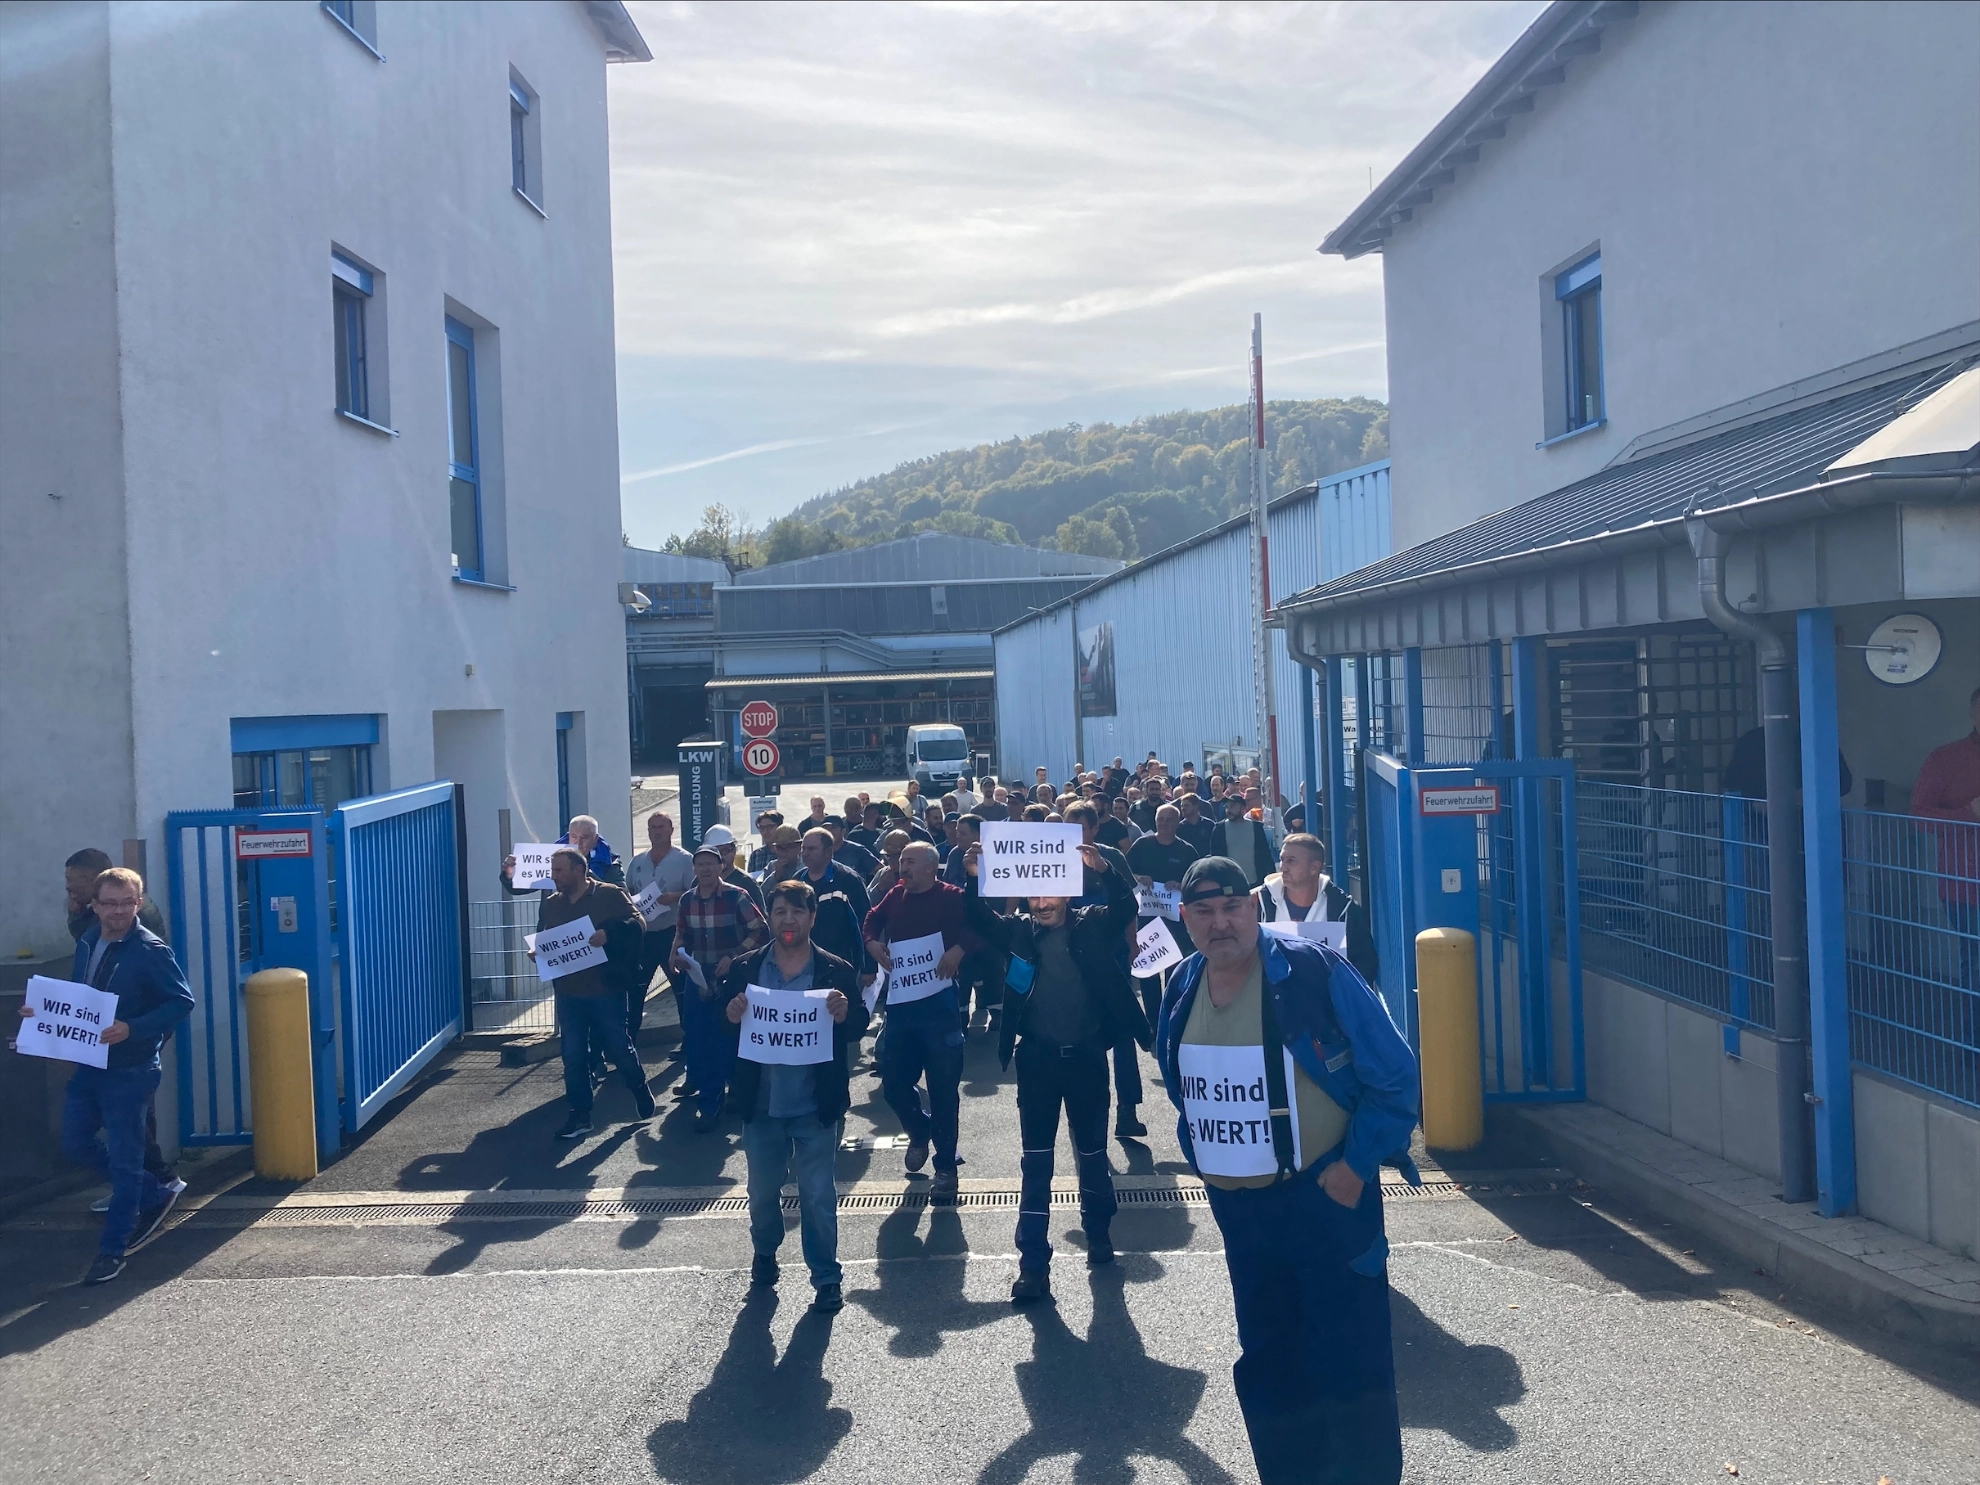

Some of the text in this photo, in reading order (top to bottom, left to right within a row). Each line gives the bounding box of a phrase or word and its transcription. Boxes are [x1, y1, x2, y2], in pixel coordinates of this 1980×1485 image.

[744, 712, 774, 727] STOP
[679, 751, 713, 763] LKW
[751, 749, 770, 765] 10
[691, 765, 702, 842] ANMELDUNG
[1425, 795, 1494, 806] Feuerwehrzufahrt
[241, 838, 307, 849] Feuerwehrzufahrt
[993, 839, 1065, 854] WIR sind
[522, 854, 542, 864] WIR
[521, 870, 533, 878] es
[992, 864, 1066, 879] es WERT!
[1153, 891, 1172, 900] sind
[538, 931, 585, 953] WIR sind
[1148, 931, 1160, 943] es
[547, 945, 593, 967] es WERT!
[907, 949, 934, 967] sind
[1150, 945, 1169, 963] WIR
[1130, 958, 1148, 970] sin
[899, 968, 939, 988] WERT!
[43, 998, 101, 1025] WIR sind
[752, 1004, 818, 1024] WIR sind
[37, 1022, 99, 1047] es WERT!
[750, 1031, 818, 1047] es WERT!
[1180, 1075, 1265, 1102] WIR sind
[1198, 1118, 1271, 1145] WERT!
